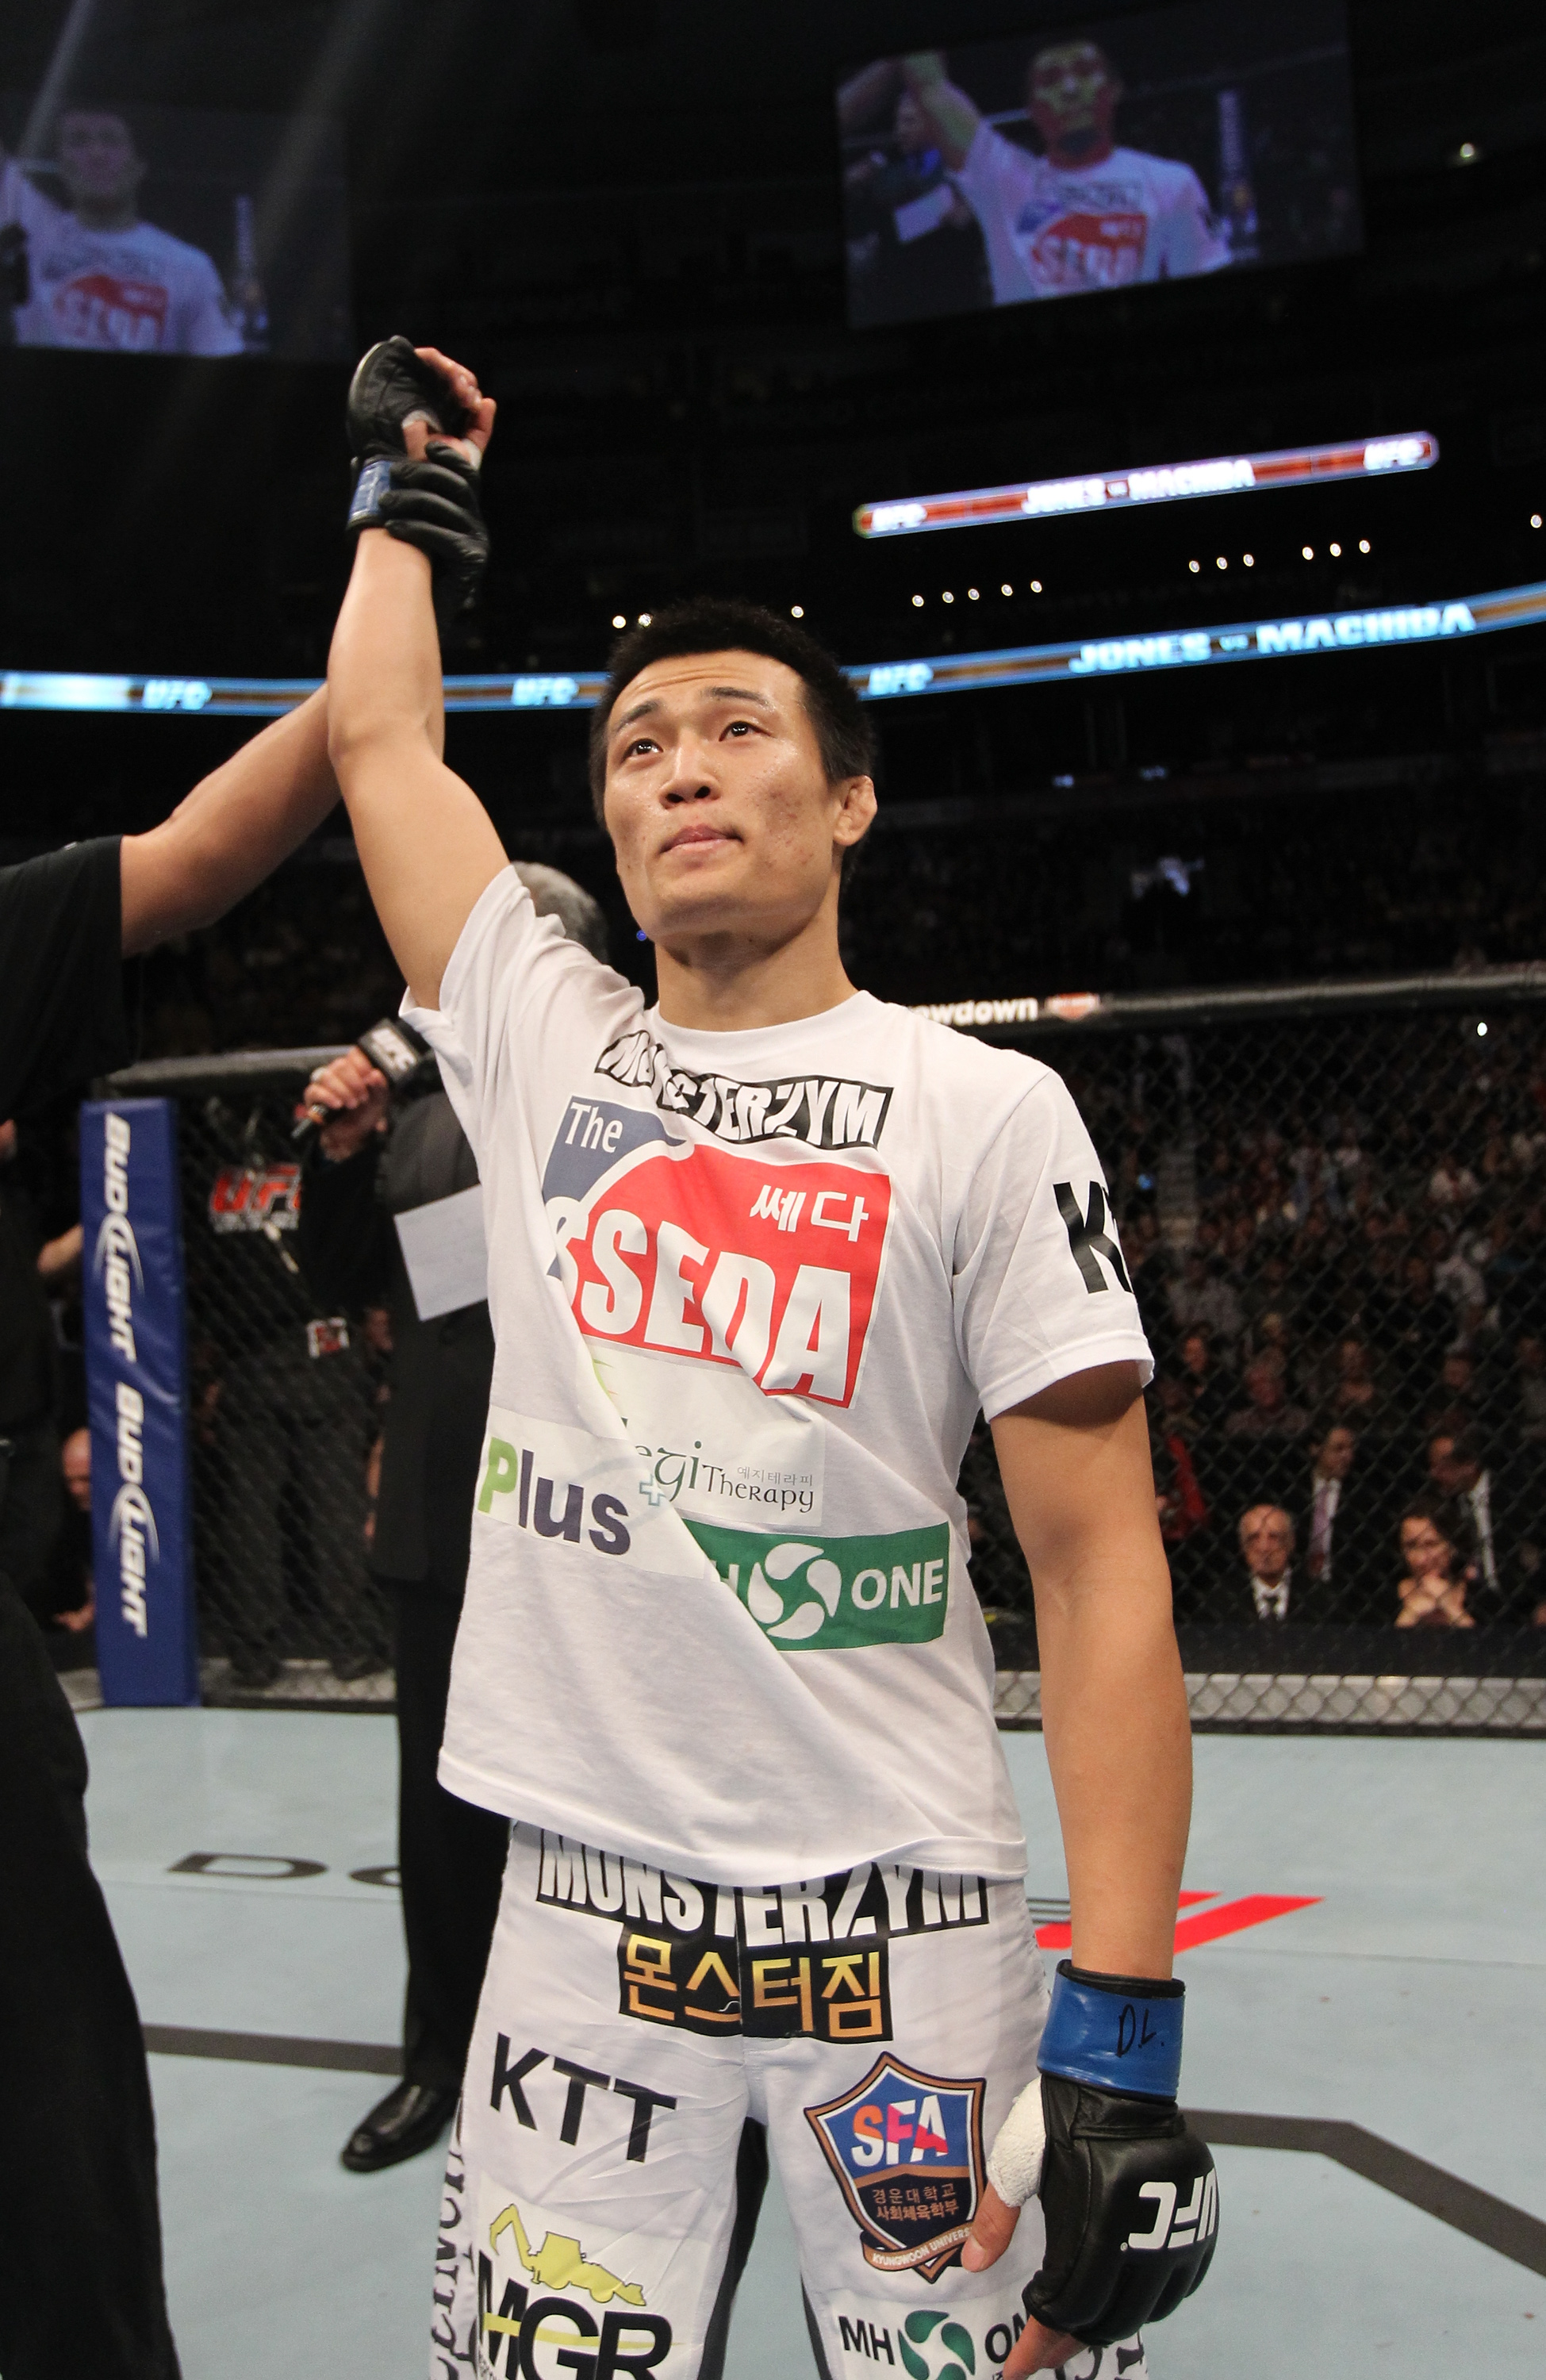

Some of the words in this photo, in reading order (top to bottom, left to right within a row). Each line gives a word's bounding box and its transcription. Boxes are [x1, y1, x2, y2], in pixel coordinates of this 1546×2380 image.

[1068, 632, 1211, 674] JONES
[1256, 603, 1475, 654] MACHIDA
[105, 1112, 131, 1215] BUD
[563, 1100, 623, 1153] The
[105, 1230, 136, 1362] LIGHT
[116, 1381, 144, 1484] BUD
[737, 1466, 813, 1488] 예지테라피
[478, 1437, 631, 1556] Plus
[121, 1498, 148, 1638] LIGHT
[851, 1559, 944, 1610] ONE
[623, 1933, 883, 2038] 몬스터짐
[490, 2032, 678, 2163] KTT
[850, 2094, 949, 2167] SFA
[873, 2244, 930, 2267] KYUNGWOON
[928, 2226, 969, 2251] UNIVERS
[1128, 2167, 1218, 2250] UFC
[478, 2250, 673, 2380] MGR
[838, 2316, 896, 2367] MH
